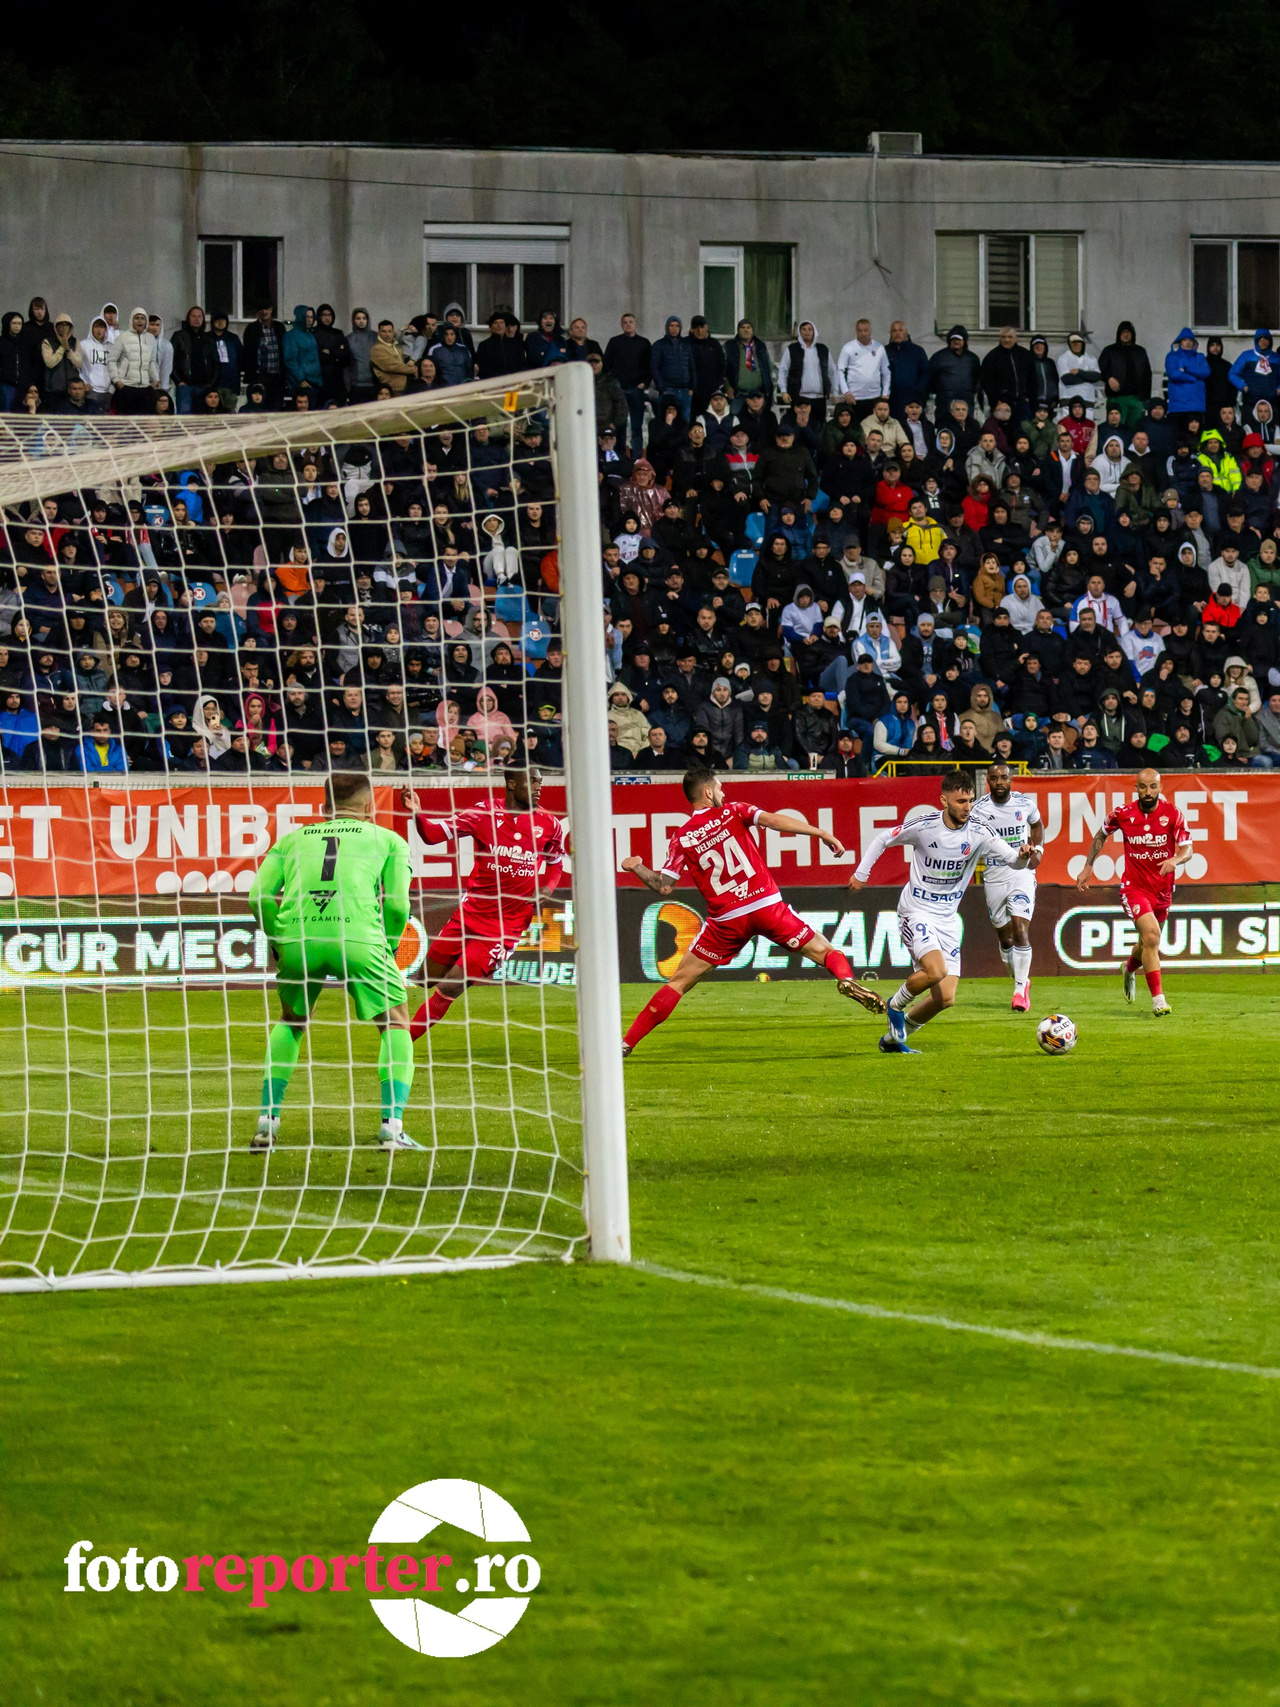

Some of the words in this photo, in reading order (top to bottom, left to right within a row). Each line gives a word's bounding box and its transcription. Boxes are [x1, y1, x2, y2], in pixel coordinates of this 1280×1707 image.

[110, 804, 323, 860] UNIBE
[1030, 791, 1248, 844] UNIET
[320, 836, 340, 882] 1
[699, 836, 756, 896] 24
[924, 856, 970, 871] UNIBET
[912, 887, 964, 902] ELSACO
[0, 931, 119, 973] GUR
[1158, 916, 1223, 956] UN
